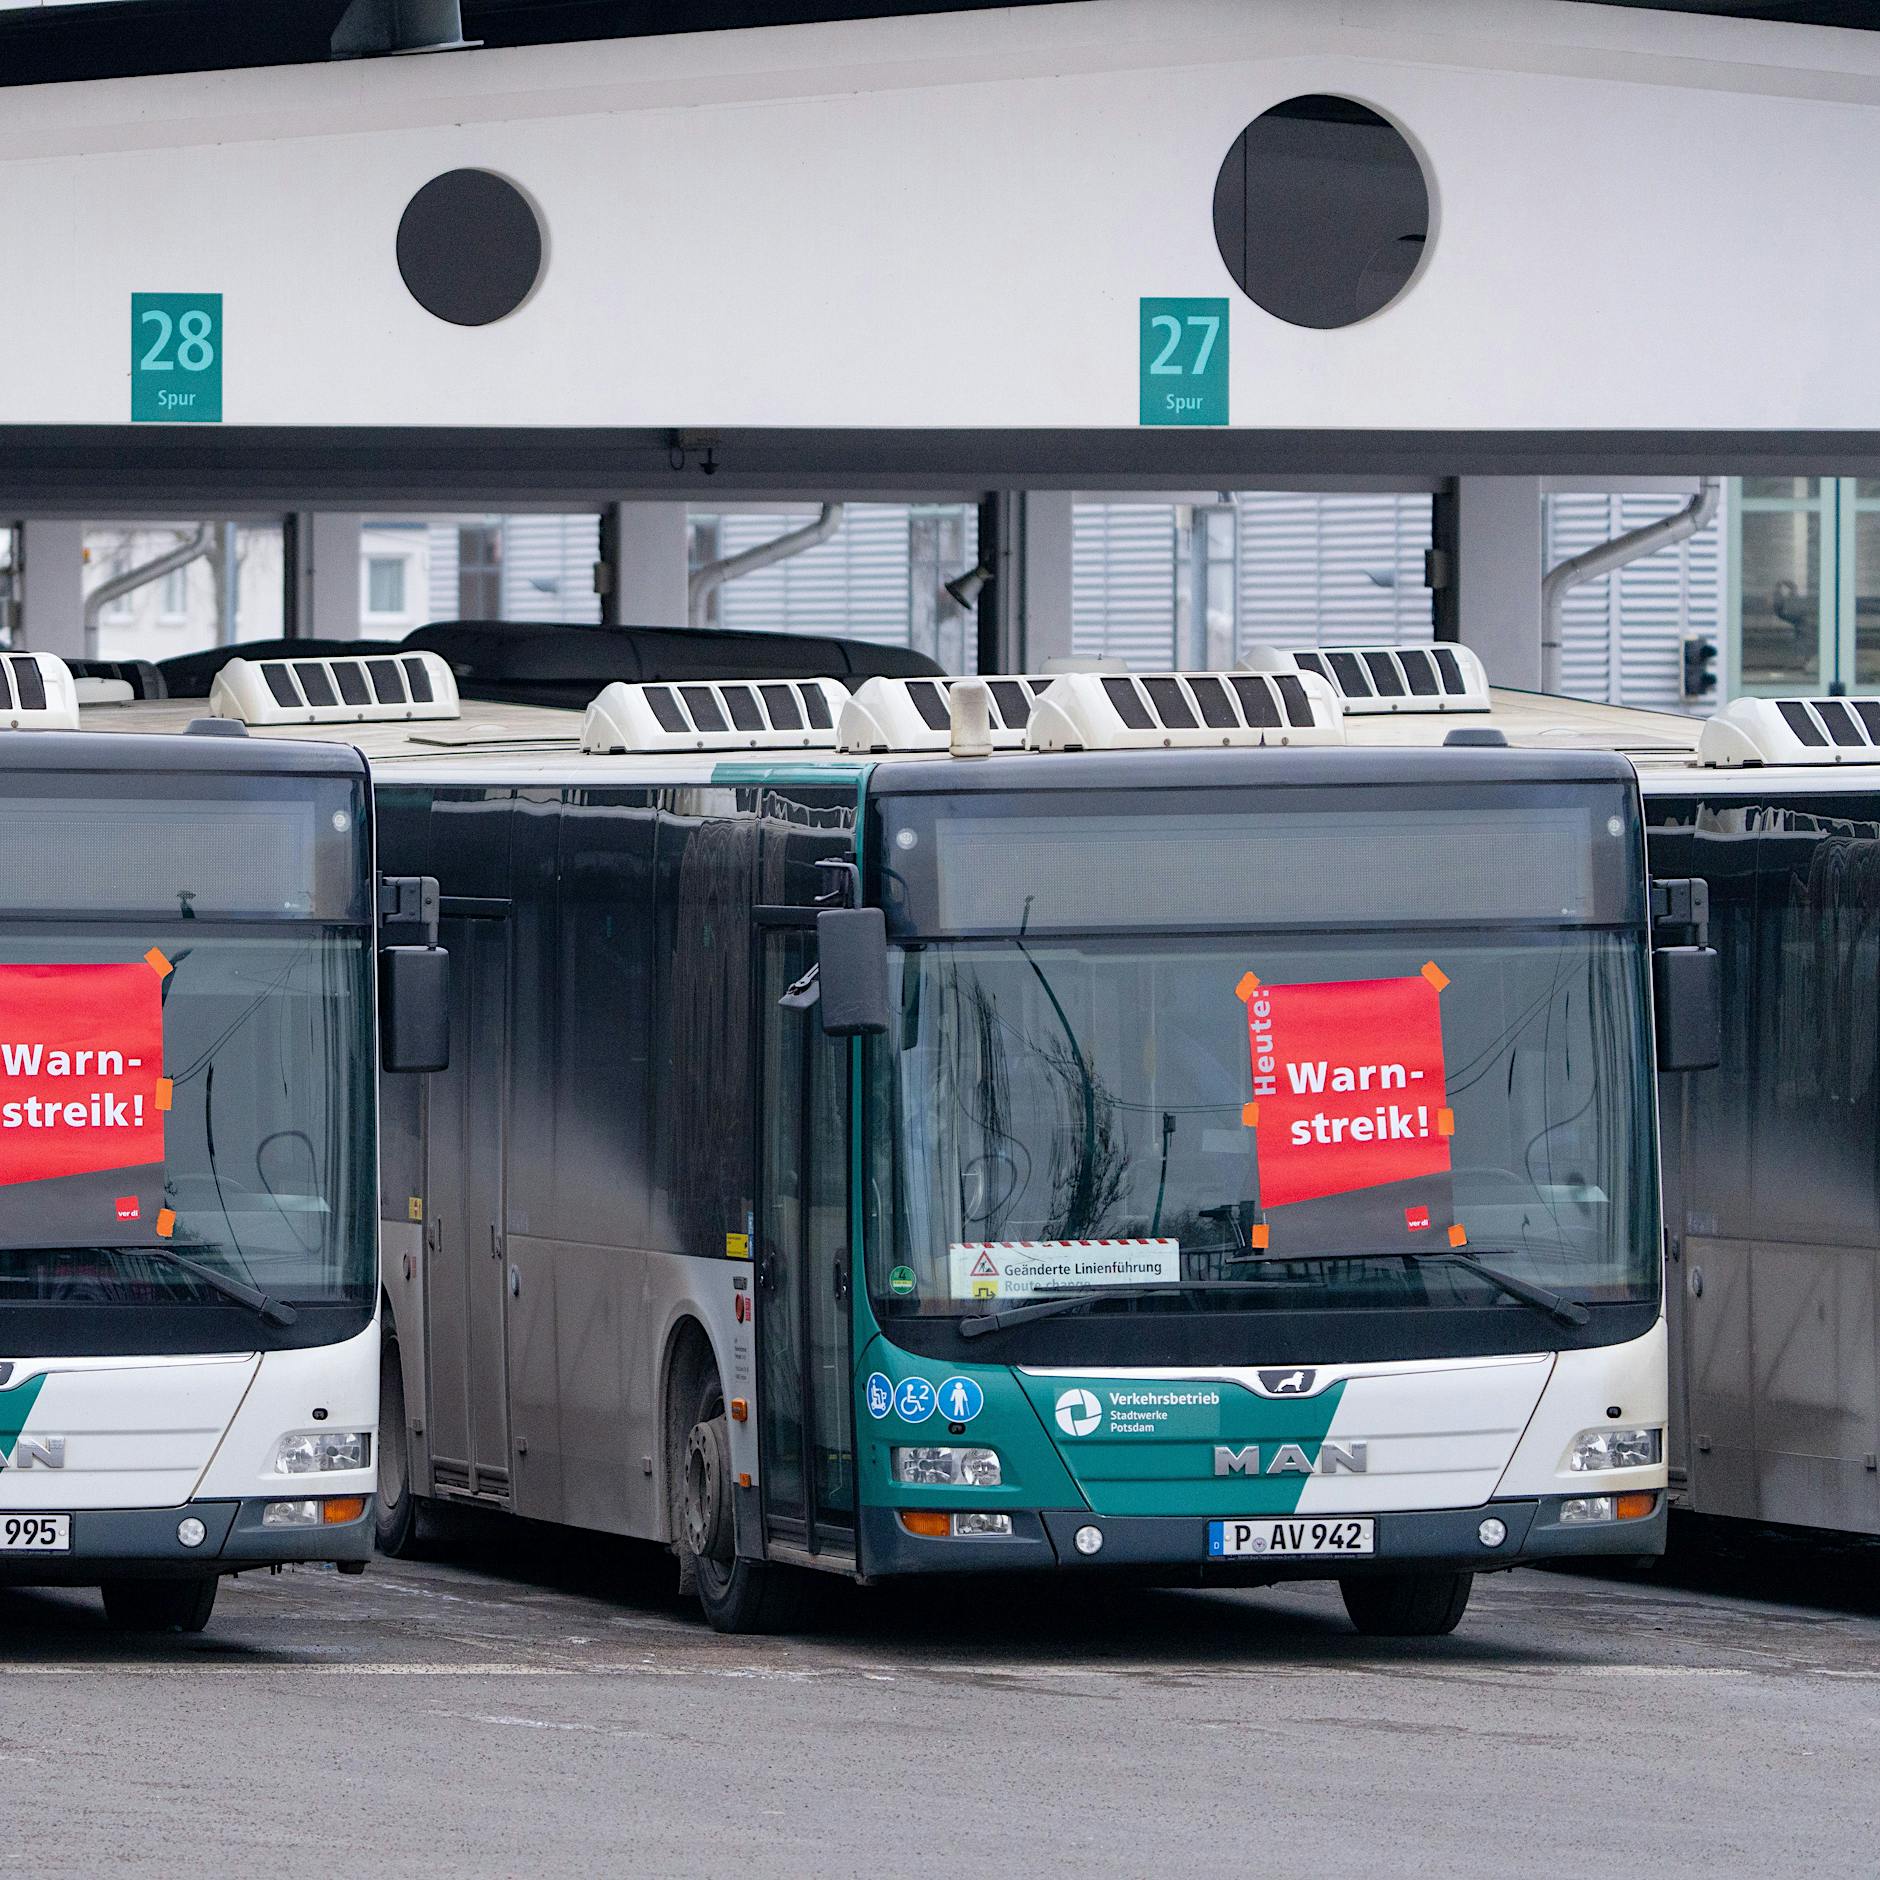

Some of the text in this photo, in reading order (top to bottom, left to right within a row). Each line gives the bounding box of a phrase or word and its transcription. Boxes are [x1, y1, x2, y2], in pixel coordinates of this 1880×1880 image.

[140, 309, 214, 371] 28
[1150, 314, 1220, 375] 27
[158, 389, 196, 410] Spur
[1166, 393, 1204, 414] Spur
[1250, 989, 1276, 1096] Heute:
[0, 1043, 142, 1076] Warn-
[1286, 1061, 1424, 1094] Warn-
[2, 1092, 143, 1128] streik!
[1291, 1105, 1429, 1145] streik!
[898, 1268, 907, 1280] 4
[1004, 1260, 1162, 1276] Geänderte Linienführung
[1004, 1280, 1041, 1292] Route
[918, 1385, 930, 1400] 2
[1109, 1392, 1220, 1406] Verkehrsbetrieb
[1110, 1410, 1168, 1420] Stadtwerke
[1110, 1422, 1155, 1433] Potsdam
[0, 1435, 65, 1469] N
[1214, 1440, 1368, 1476] MAN
[5, 1518, 57, 1545] 995
[1213, 1522, 1362, 1551] D P AV 942
